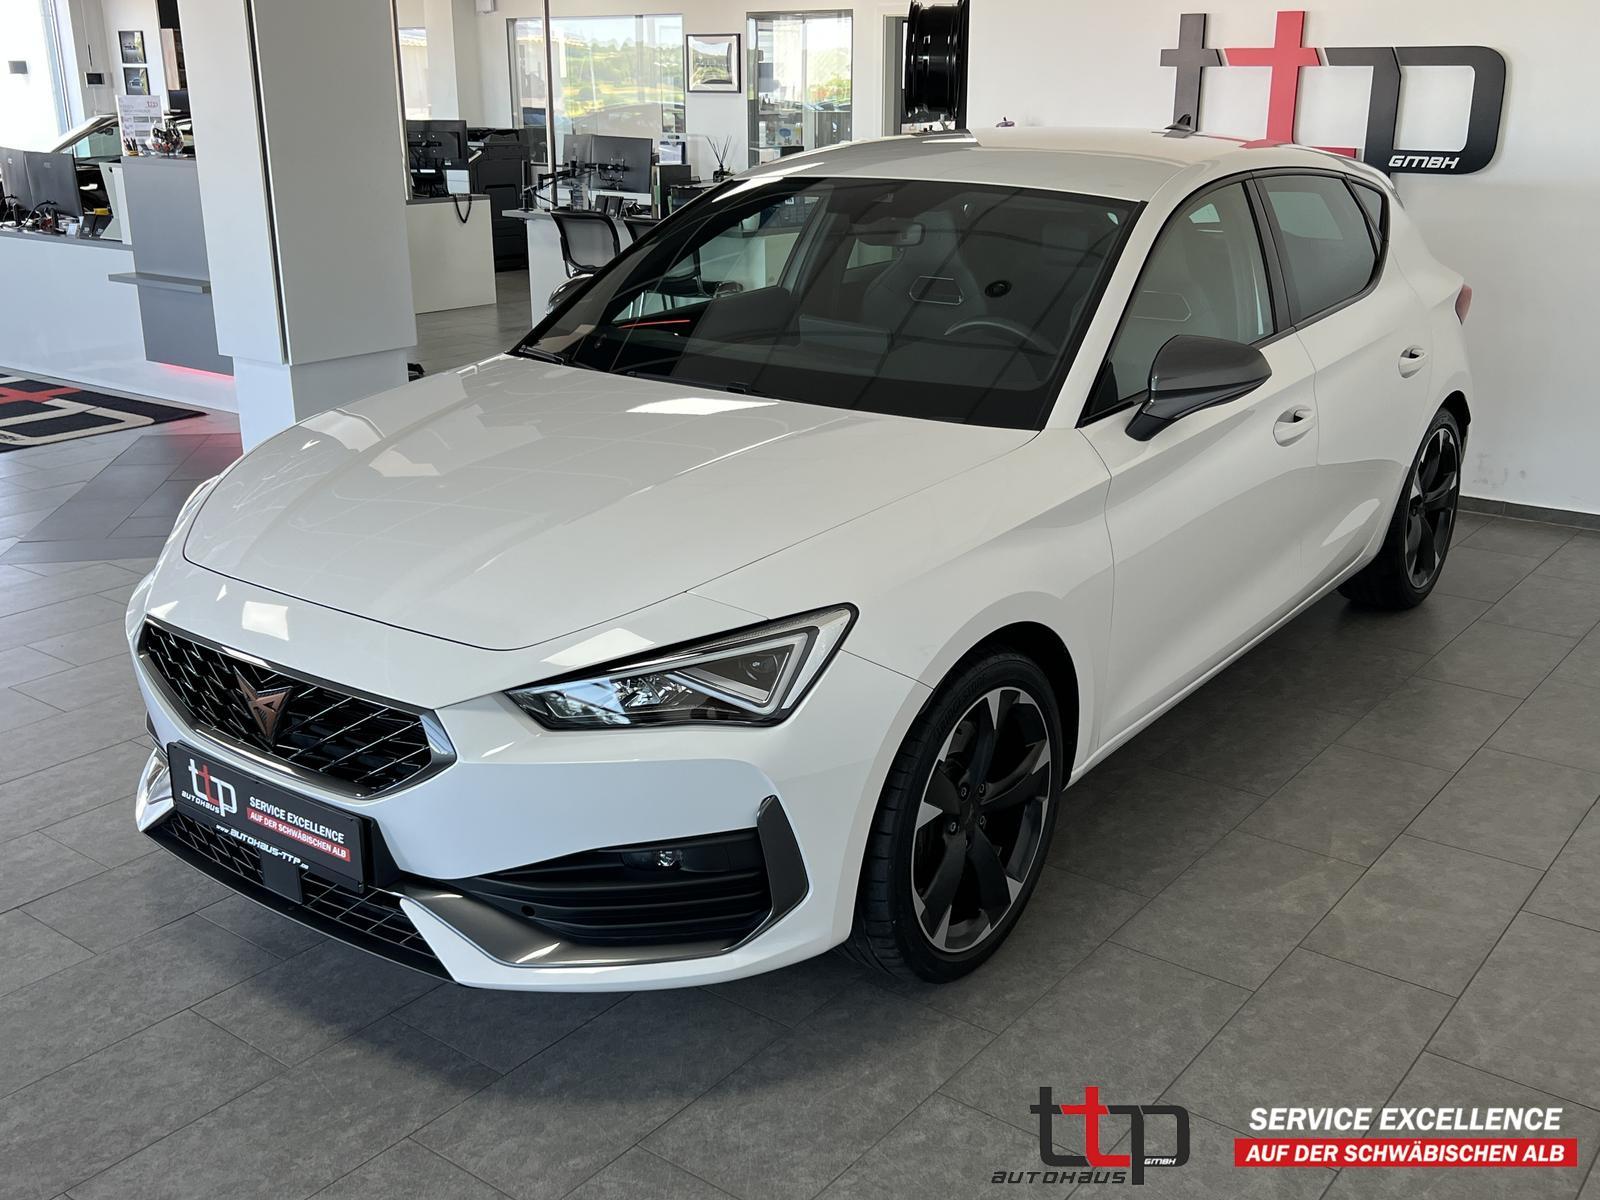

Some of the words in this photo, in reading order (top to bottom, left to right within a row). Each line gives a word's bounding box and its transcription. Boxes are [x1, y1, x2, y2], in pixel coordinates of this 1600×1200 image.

[188, 758, 238, 817] ttp
[249, 796, 286, 821] SERVICE
[287, 812, 345, 845] EXCELLENCE
[250, 811, 263, 823] AUF
[263, 817, 278, 829] DER
[278, 823, 332, 852] SCHWÄBISCHEN
[332, 844, 347, 858] ALB
